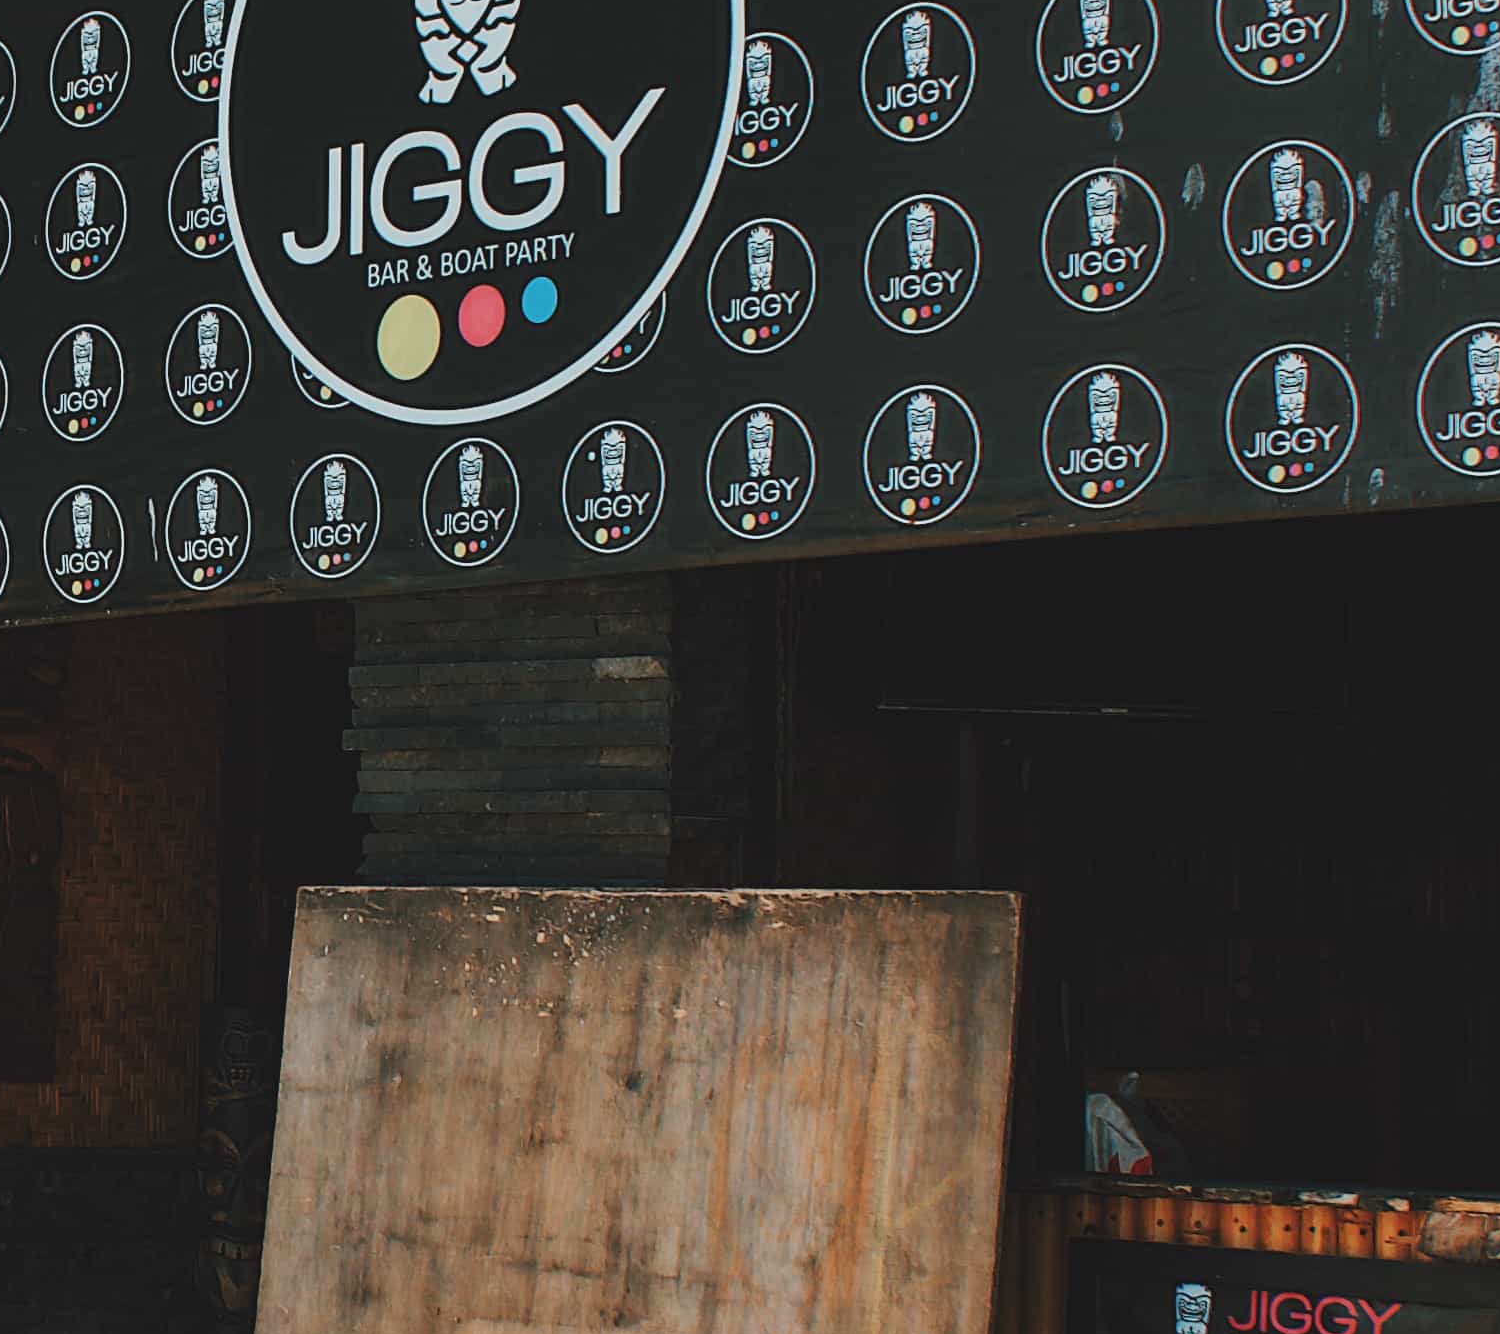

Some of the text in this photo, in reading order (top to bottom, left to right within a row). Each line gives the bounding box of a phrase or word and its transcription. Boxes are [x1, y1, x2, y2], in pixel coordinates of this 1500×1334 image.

[1235, 13, 1328, 52] JIGGY
[1053, 44, 1141, 82] JIGGY
[60, 71, 118, 102] JIGGY
[877, 75, 959, 111] JIGGY
[281, 87, 667, 265] JIGGY
[56, 224, 115, 254] JIGGY
[1241, 219, 1336, 256] JIGGY
[367, 233, 575, 287] BAR & BOAT PARTY
[1058, 244, 1147, 279] JIGGY
[879, 268, 963, 302] JIGGY
[721, 290, 800, 323] JIGGY
[177, 368, 239, 397] JIGGY
[53, 387, 112, 414] JIGGY
[1243, 425, 1340, 458] JIGGY
[1058, 443, 1149, 475] JIGGY
[720, 477, 800, 507] JIGGY
[878, 460, 963, 492] JIGGY
[436, 508, 505, 536] JIGGY
[576, 492, 650, 522] JIGGY
[178, 535, 238, 562] JIGGY
